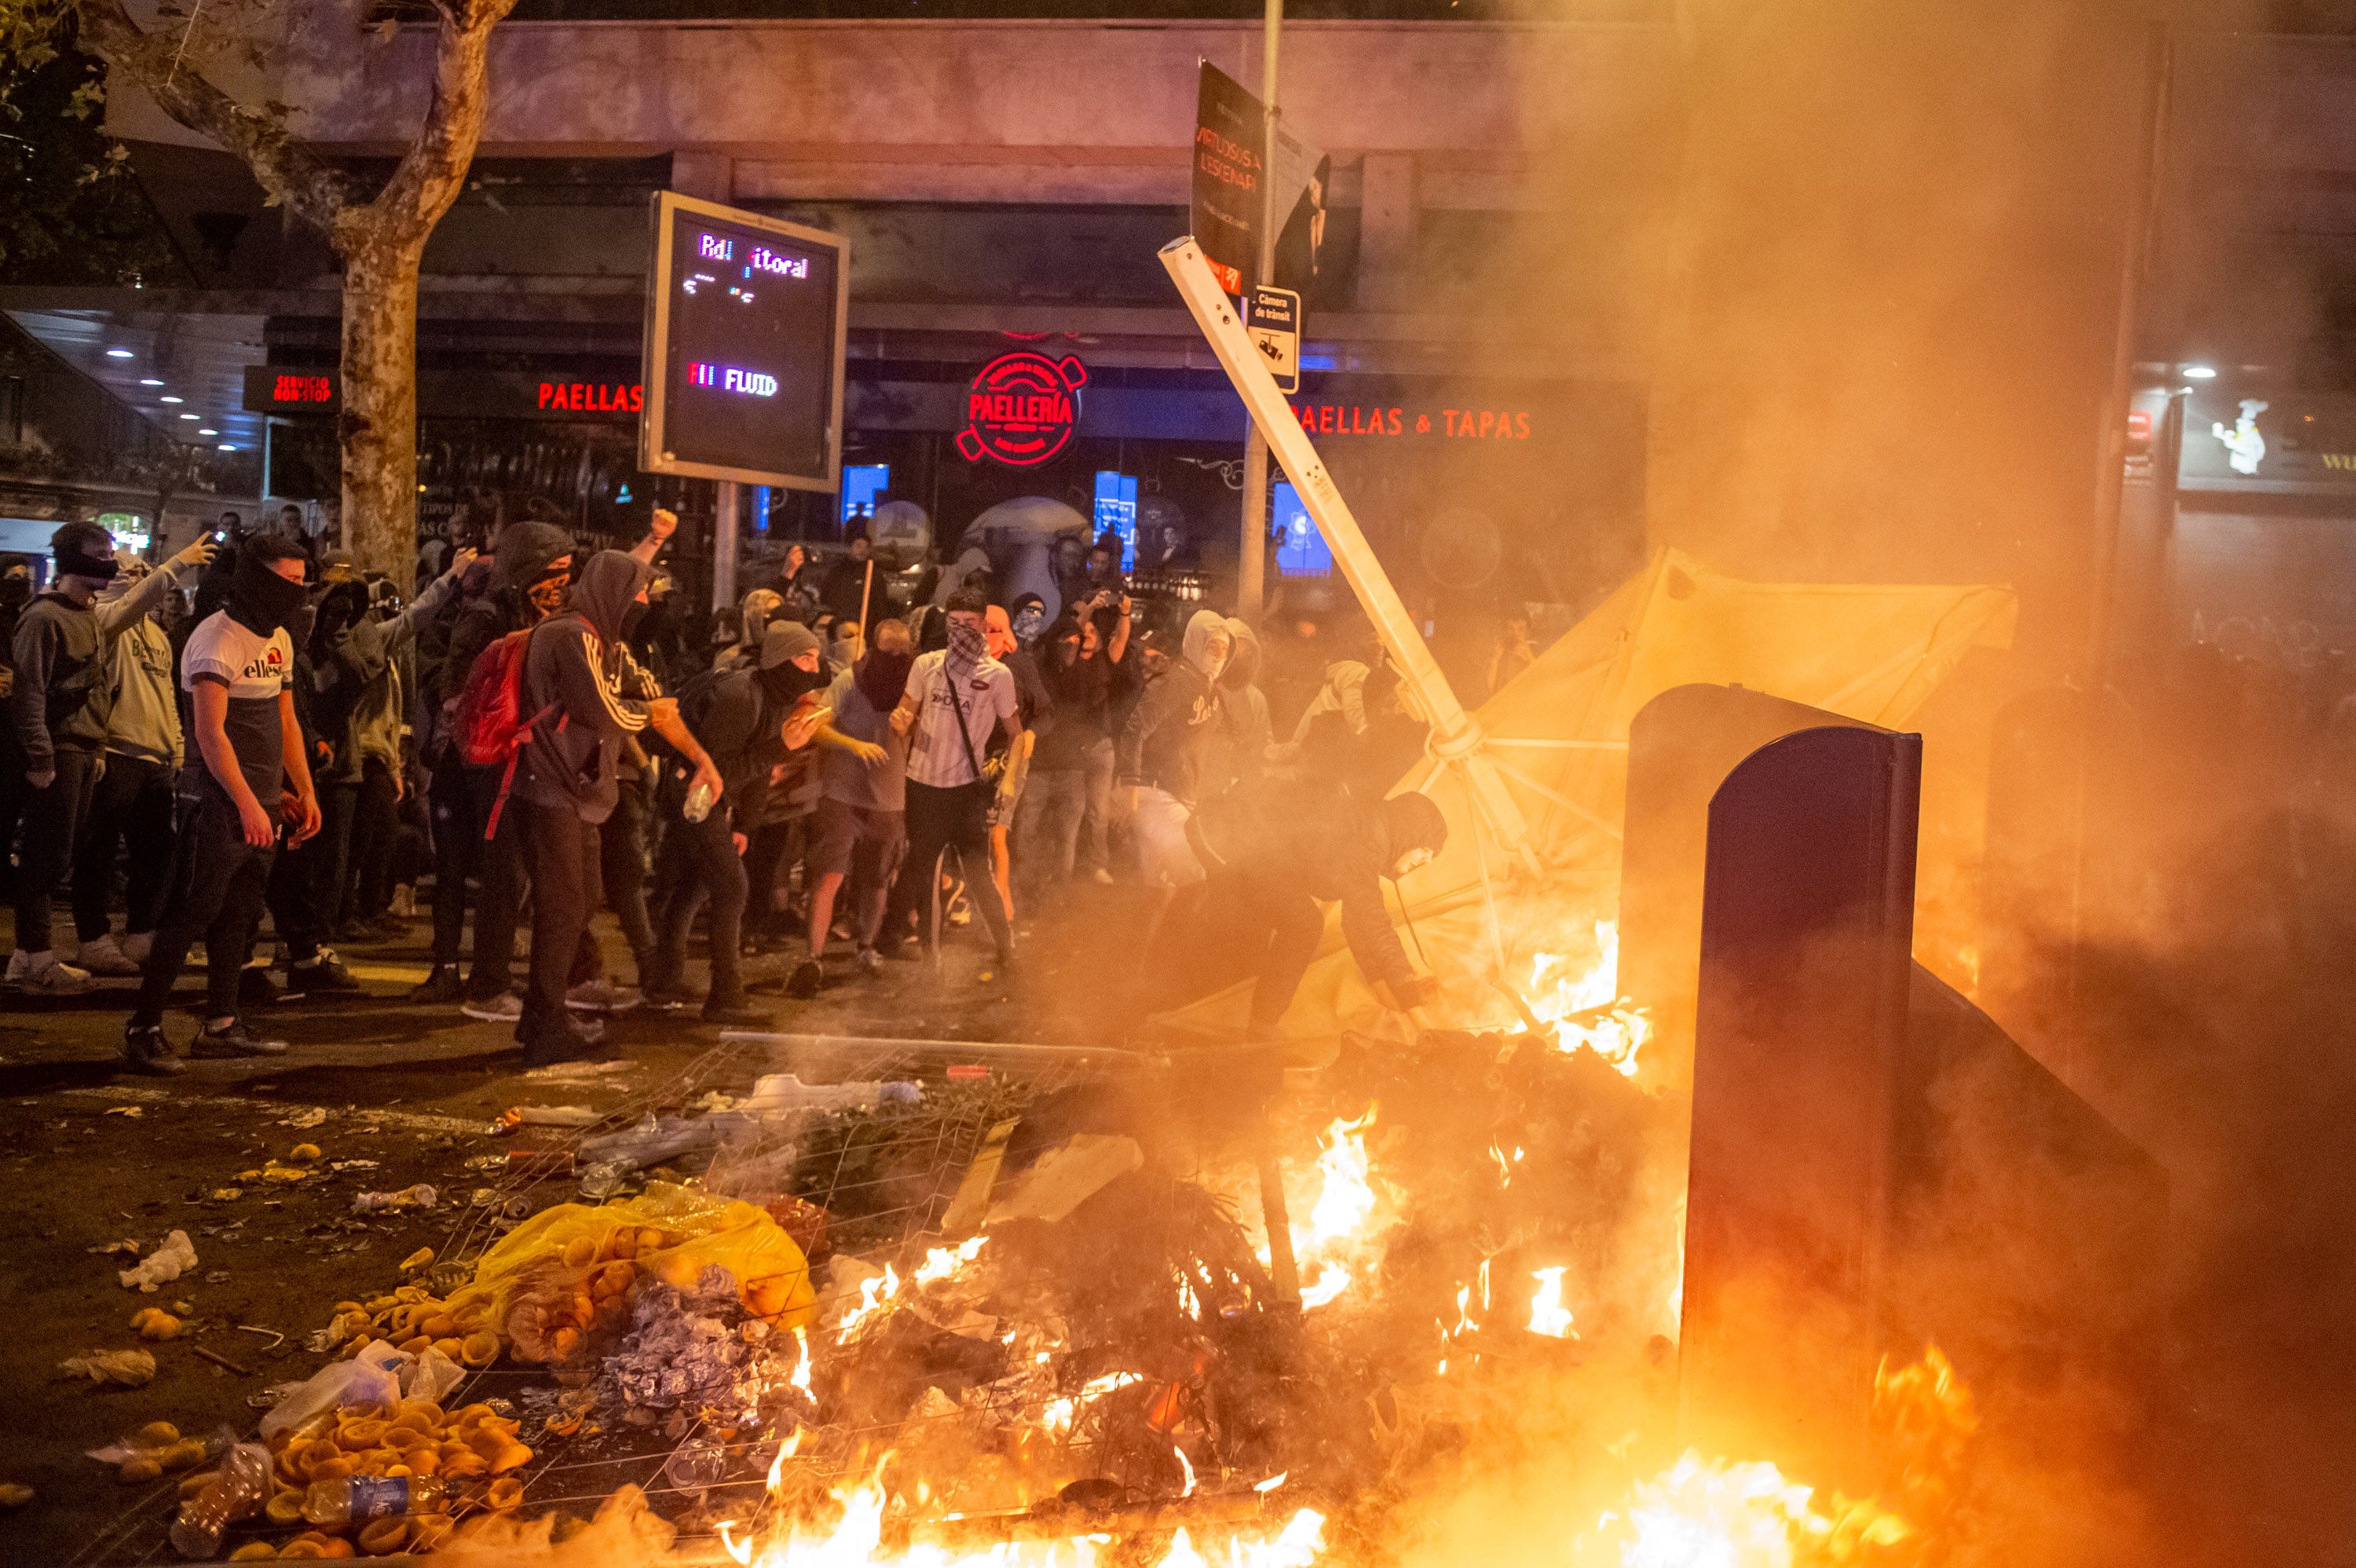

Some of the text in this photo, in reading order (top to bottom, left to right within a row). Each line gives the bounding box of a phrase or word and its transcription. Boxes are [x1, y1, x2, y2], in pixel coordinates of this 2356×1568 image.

[748, 247, 808, 280] itoral
[273, 388, 332, 402] NON-STOP
[275, 375, 330, 390] SERVICIO
[538, 382, 644, 412] PAELLAS
[725, 367, 778, 397] FLUID
[968, 391, 1074, 424] PAELLERÍA
[1289, 404, 1531, 440] AELLAS & TAPAS
